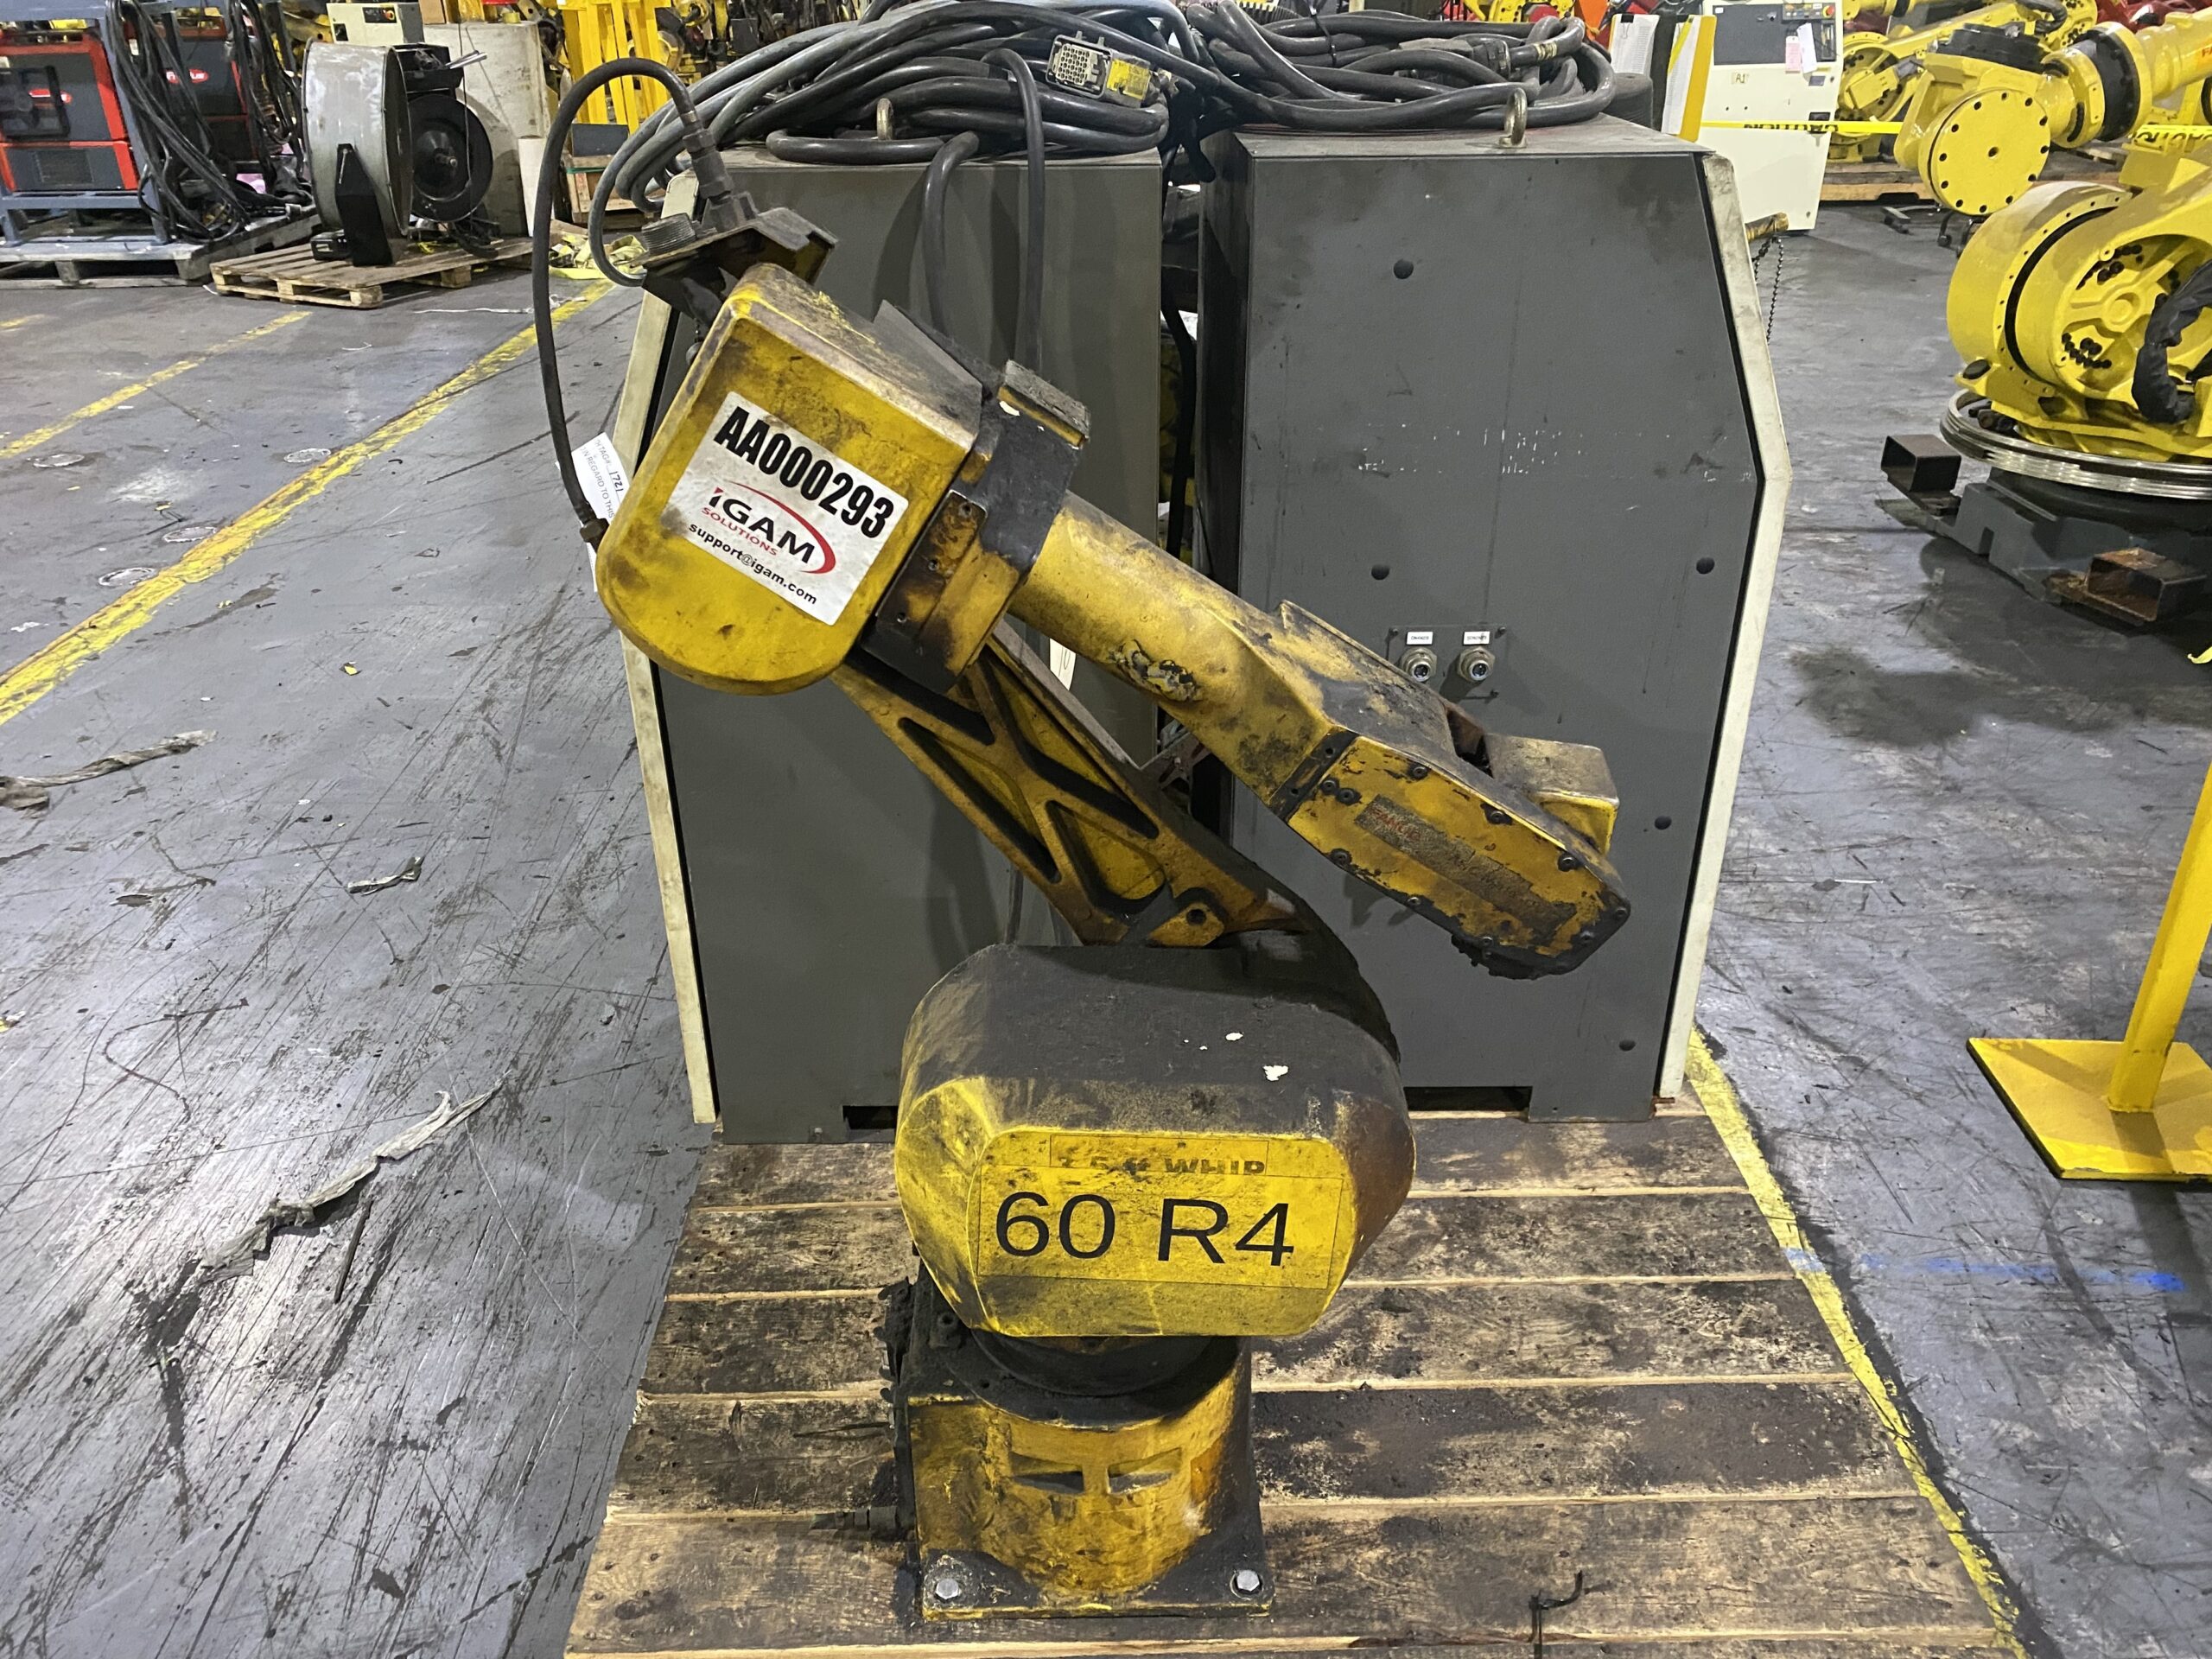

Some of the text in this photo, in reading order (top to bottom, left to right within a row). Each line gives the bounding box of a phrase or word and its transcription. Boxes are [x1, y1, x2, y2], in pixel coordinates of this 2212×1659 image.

[588, 456, 605, 487] REGARD
[601, 486, 609, 499] TO
[609, 471, 624, 492] 1721
[713, 406, 894, 538] AA000293
[702, 507, 778, 556] SOLUTIONS
[689, 523, 817, 605] support@igam.com
[995, 1191, 1294, 1267] 60 R4
